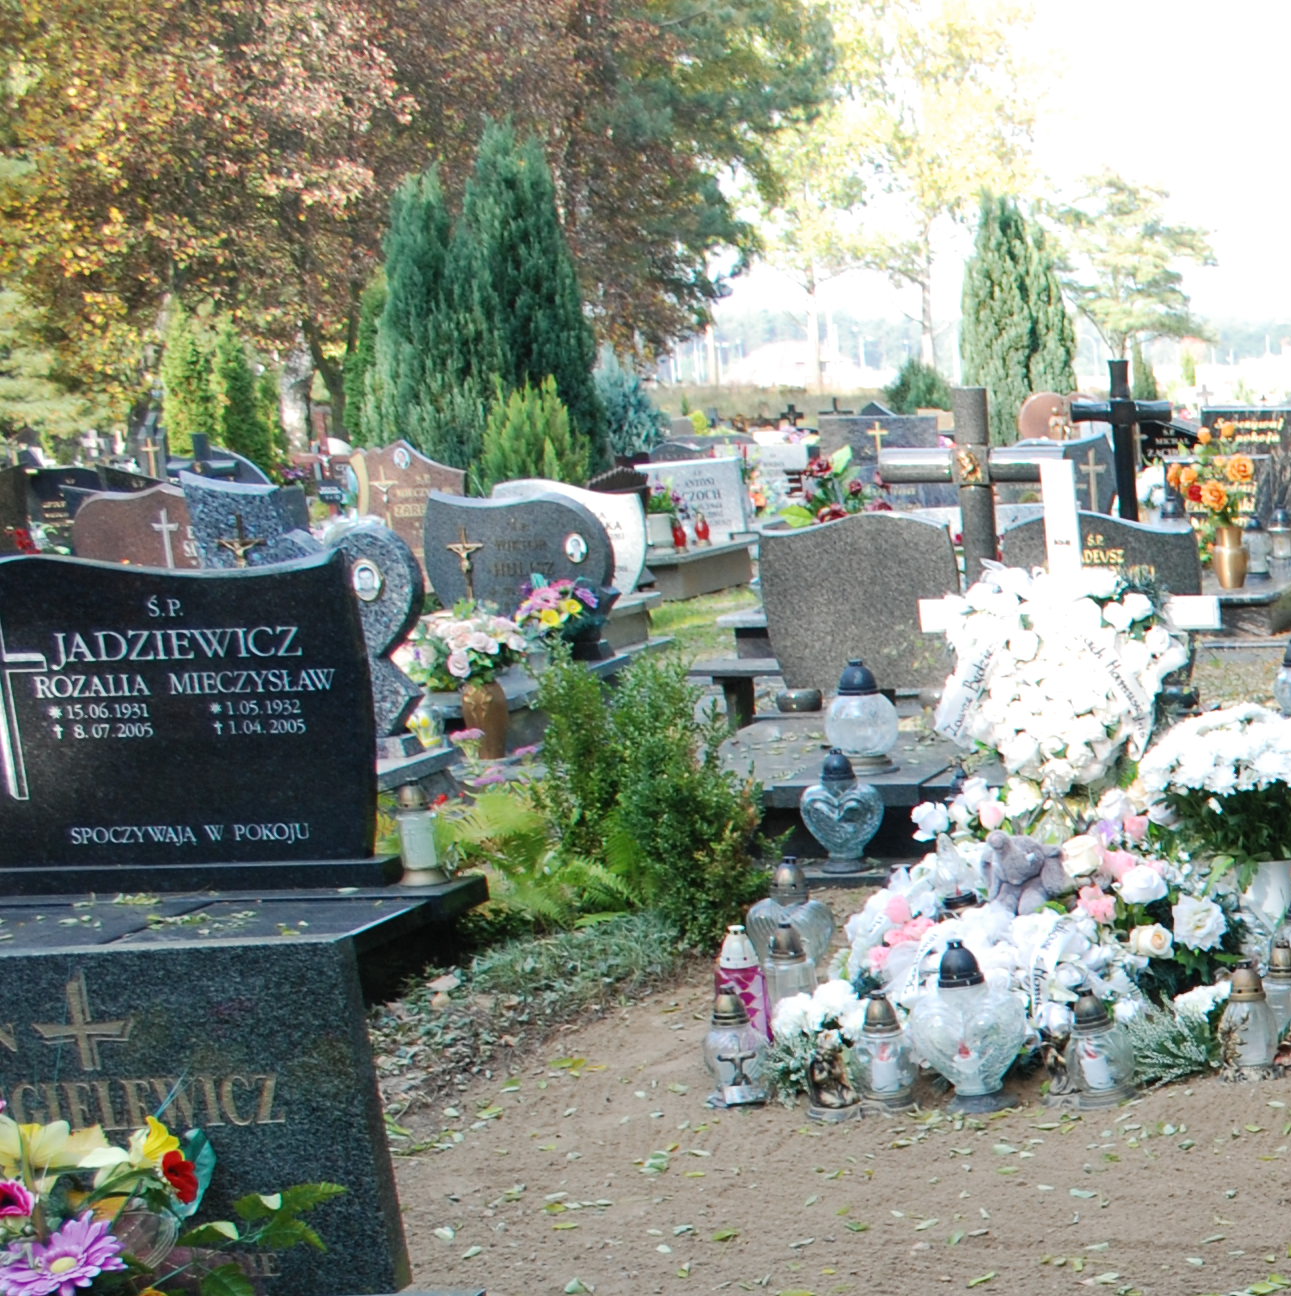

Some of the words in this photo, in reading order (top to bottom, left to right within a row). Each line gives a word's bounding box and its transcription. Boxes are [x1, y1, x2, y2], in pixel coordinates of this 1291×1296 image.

[1082, 548, 1126, 565] DEUSZ
[146, 595, 184, 618] Ś.P.
[51, 626, 303, 671] JADZIEWICZ
[33, 674, 151, 700] ROZALIA
[169, 668, 336, 696] MIECZYSŁAW
[66, 702, 150, 720] 15.06.1931
[225, 699, 302, 717] 1.05.1932
[71, 825, 198, 847] SPOCZYWAJĄ
[205, 824, 225, 842] W
[234, 822, 310, 846] POKOJU
